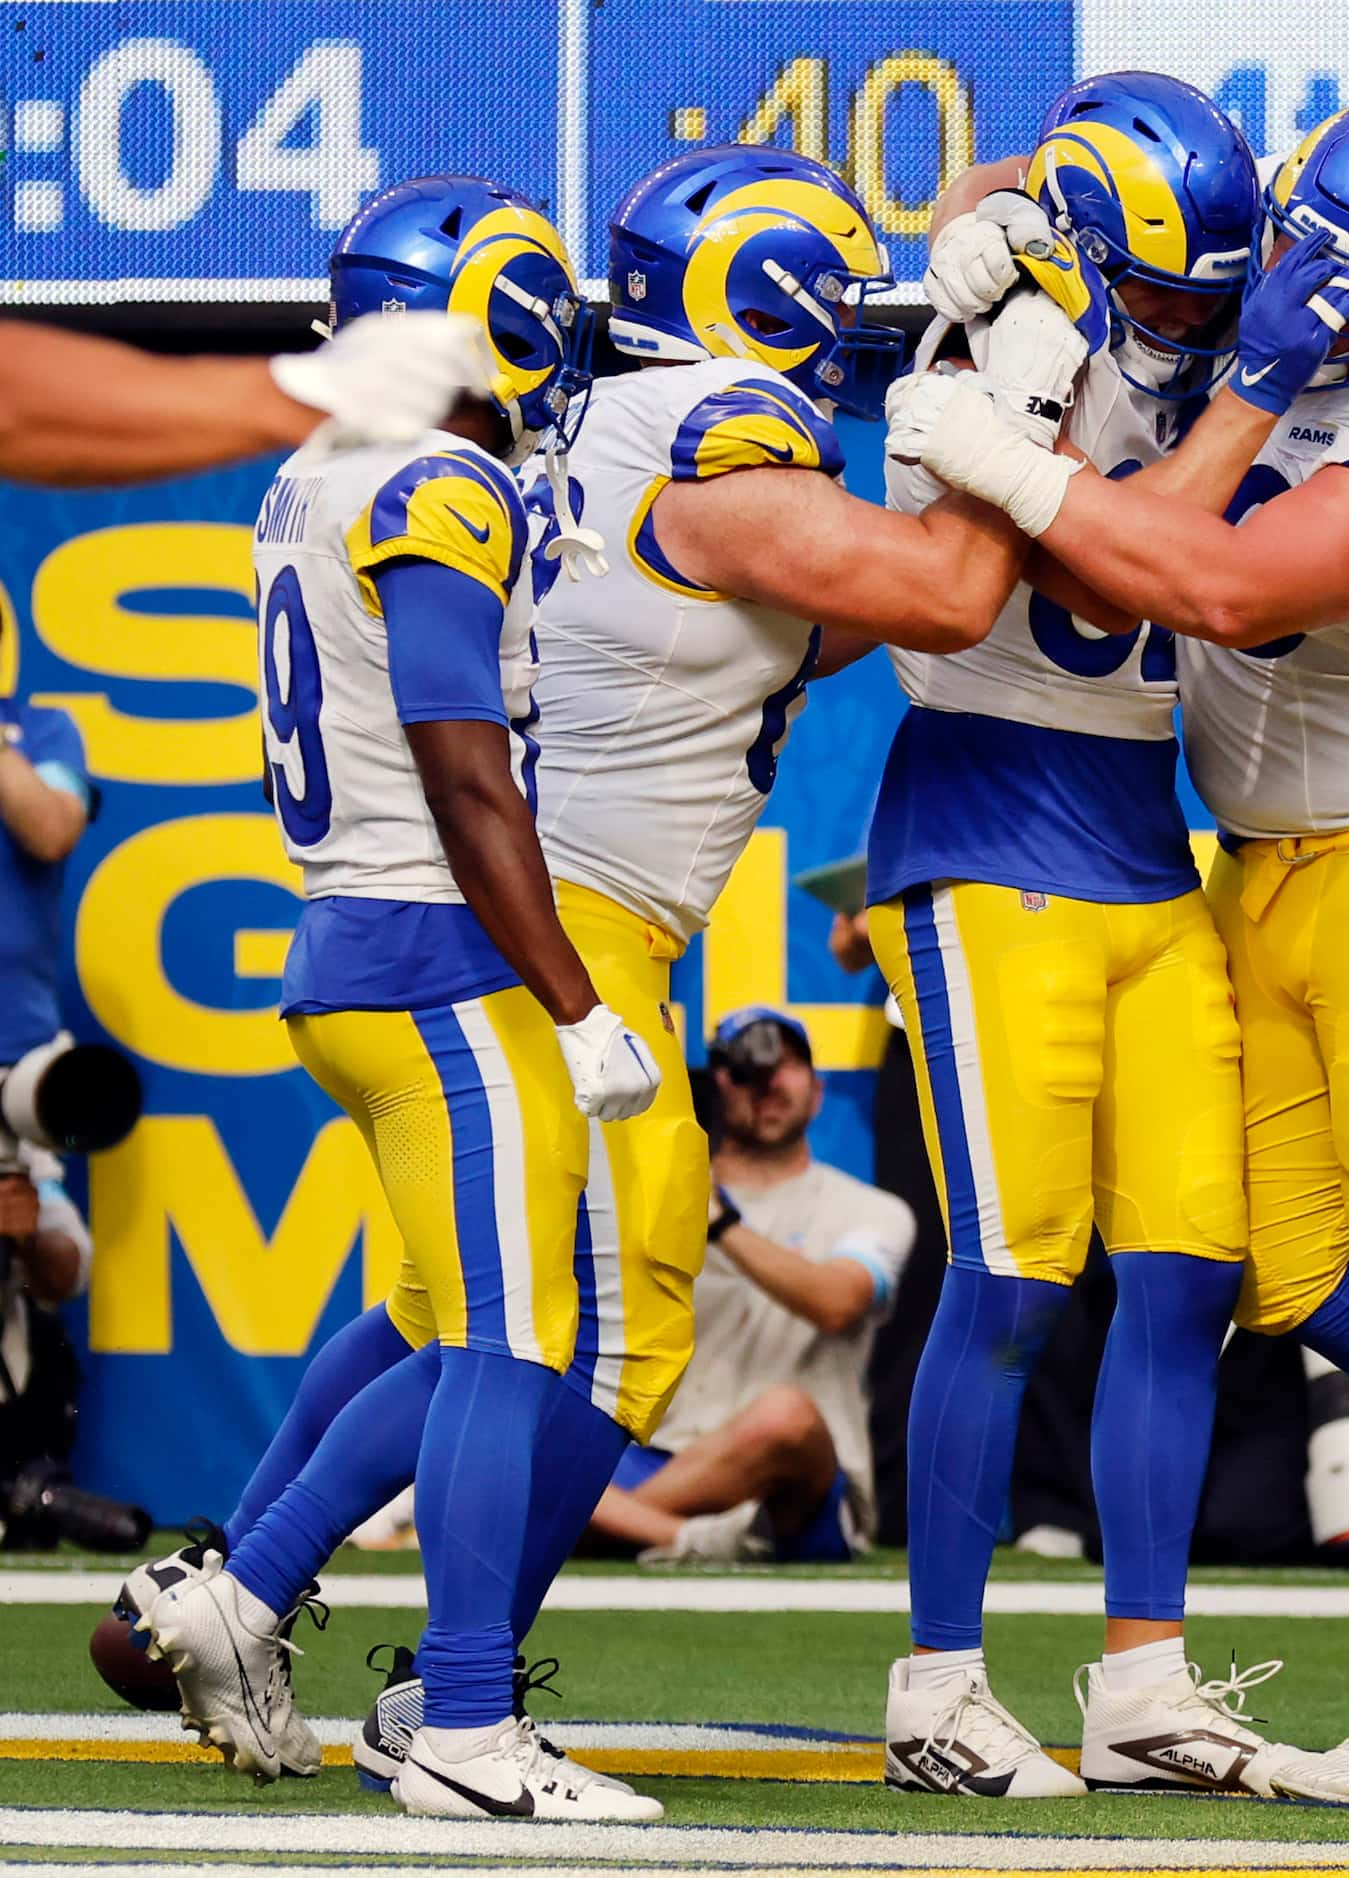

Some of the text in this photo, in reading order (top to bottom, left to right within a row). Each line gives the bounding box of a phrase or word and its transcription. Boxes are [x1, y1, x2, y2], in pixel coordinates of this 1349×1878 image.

[14, 38, 380, 231] :04
[1289, 426, 1335, 447] RAMS
[1159, 1748, 1218, 1779] ALPHA
